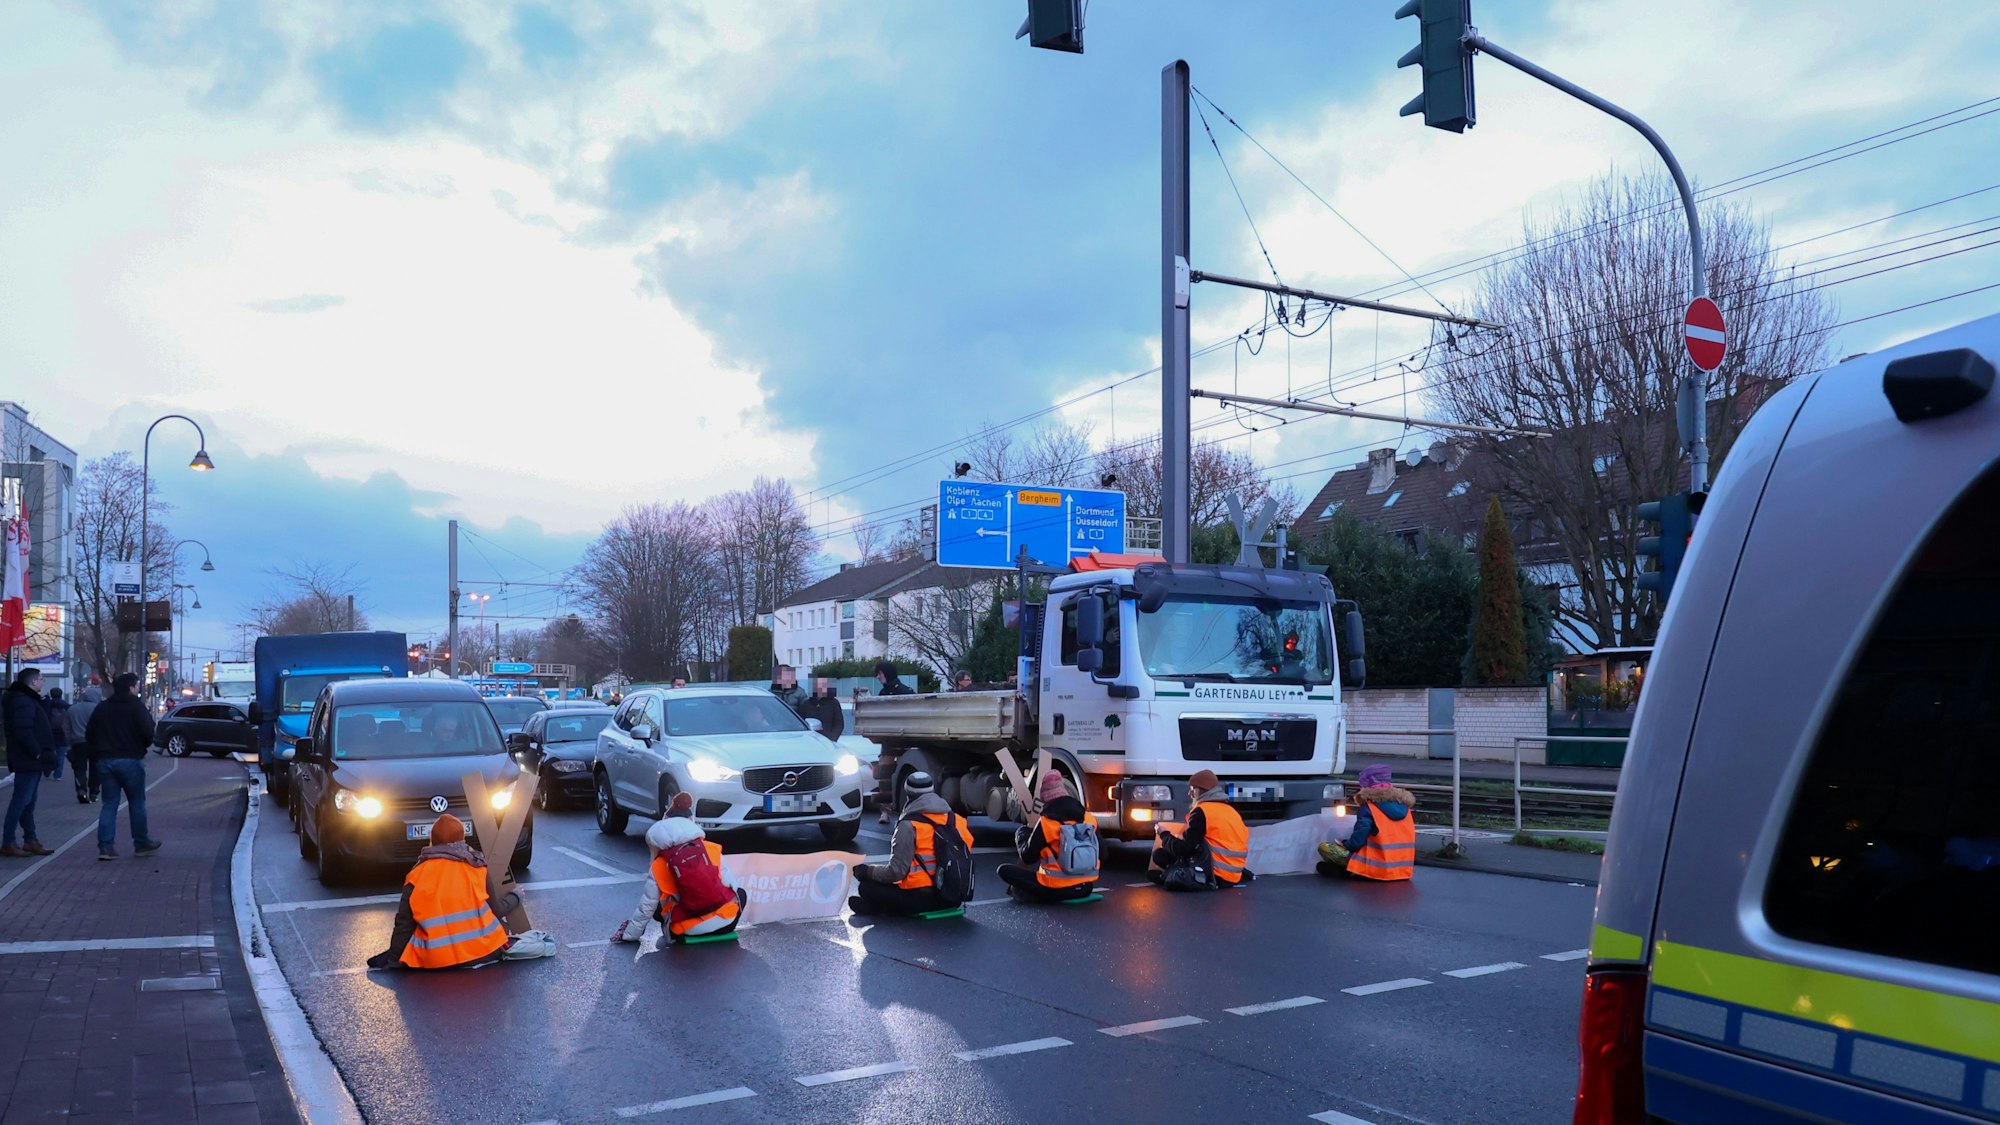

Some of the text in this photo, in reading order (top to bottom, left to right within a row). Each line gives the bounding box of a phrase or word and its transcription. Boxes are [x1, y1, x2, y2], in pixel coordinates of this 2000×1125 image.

[946, 485, 981, 497] Koblenz
[946, 495, 1002, 508] Olpe Aachen
[1020, 493, 1059, 504] Bergheim
[1075, 506, 1115, 517] Dortmund
[1195, 687, 1287, 700] GARTENBAU LEY
[1227, 729, 1276, 741] MAN
[414, 825, 427, 836] NE
